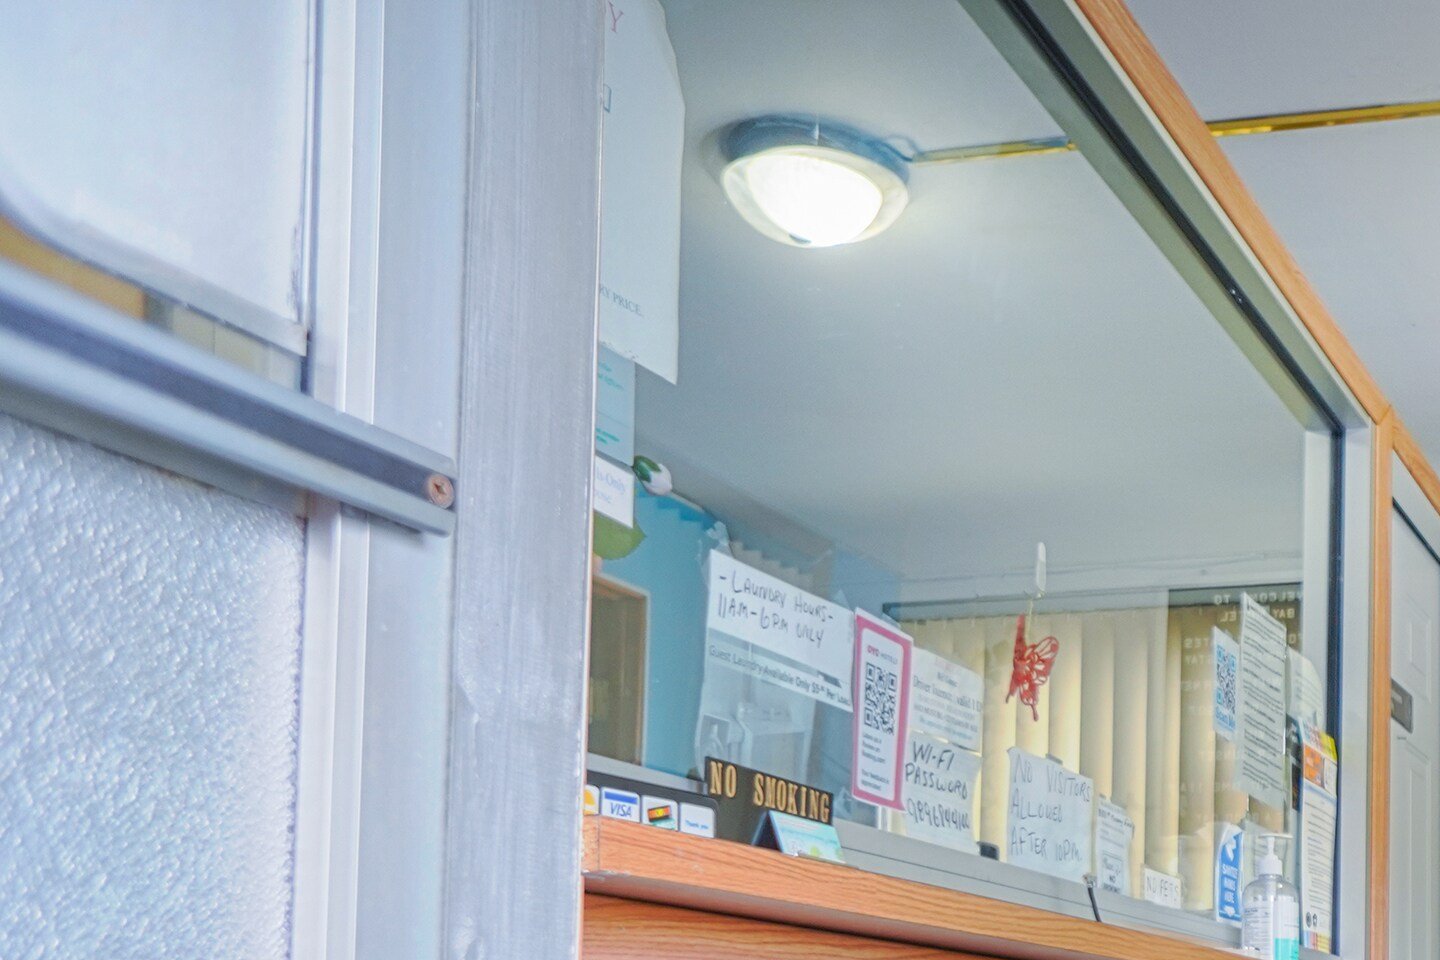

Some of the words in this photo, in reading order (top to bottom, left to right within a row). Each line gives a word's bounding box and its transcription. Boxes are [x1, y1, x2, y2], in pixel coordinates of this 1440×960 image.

[1014, 754, 1033, 784] NO
[709, 761, 737, 798] NO
[753, 773, 831, 823] SMOKING
[610, 802, 632, 818] VISA
